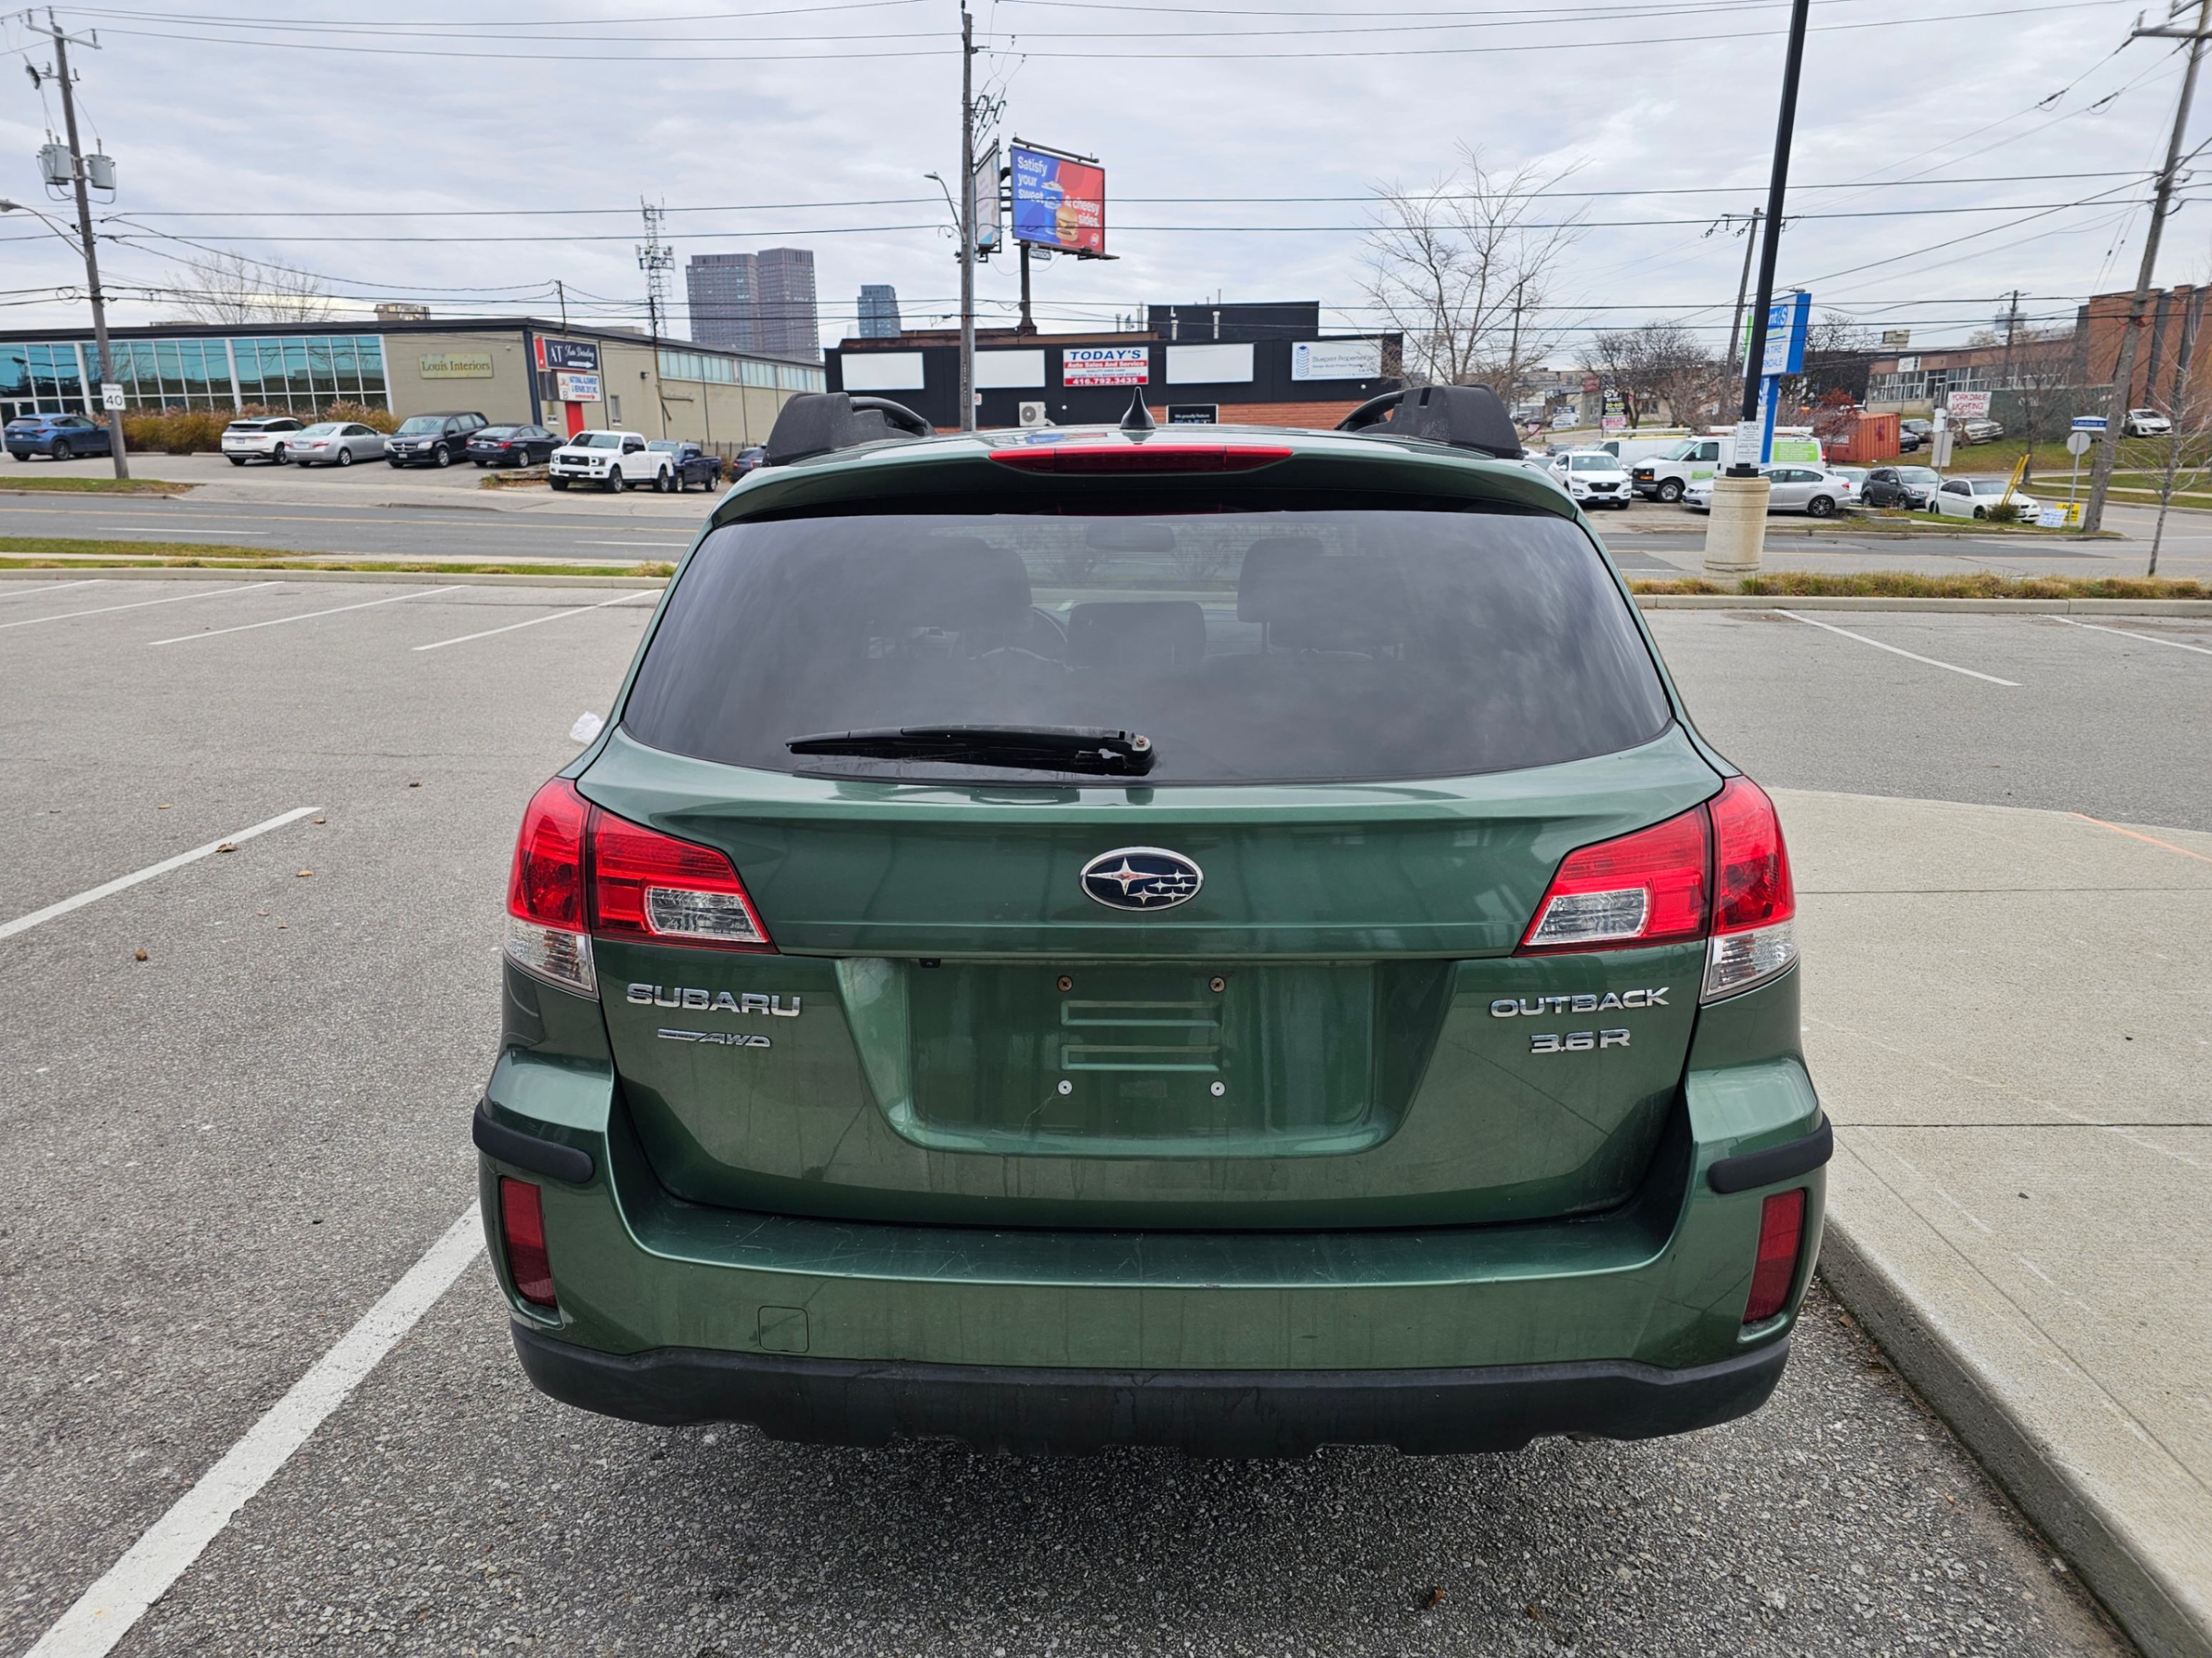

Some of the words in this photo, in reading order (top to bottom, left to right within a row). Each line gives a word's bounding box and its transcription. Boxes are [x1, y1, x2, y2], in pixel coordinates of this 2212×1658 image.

[1017, 156, 1047, 177] Satisfy
[1017, 174, 1038, 186] your
[1018, 189, 1044, 204] sweet
[1065, 195, 1072, 207] &
[1073, 197, 1100, 215] cheesy
[550, 345, 563, 362] AT
[1070, 350, 1141, 360] TODAY'S
[422, 360, 448, 371] Louis
[450, 360, 490, 371] Interiors
[107, 395, 122, 406] 40
[626, 983, 801, 1017] SUBARU
[1491, 987, 1670, 1017] OUTBACK
[698, 1032, 771, 1047] AWD
